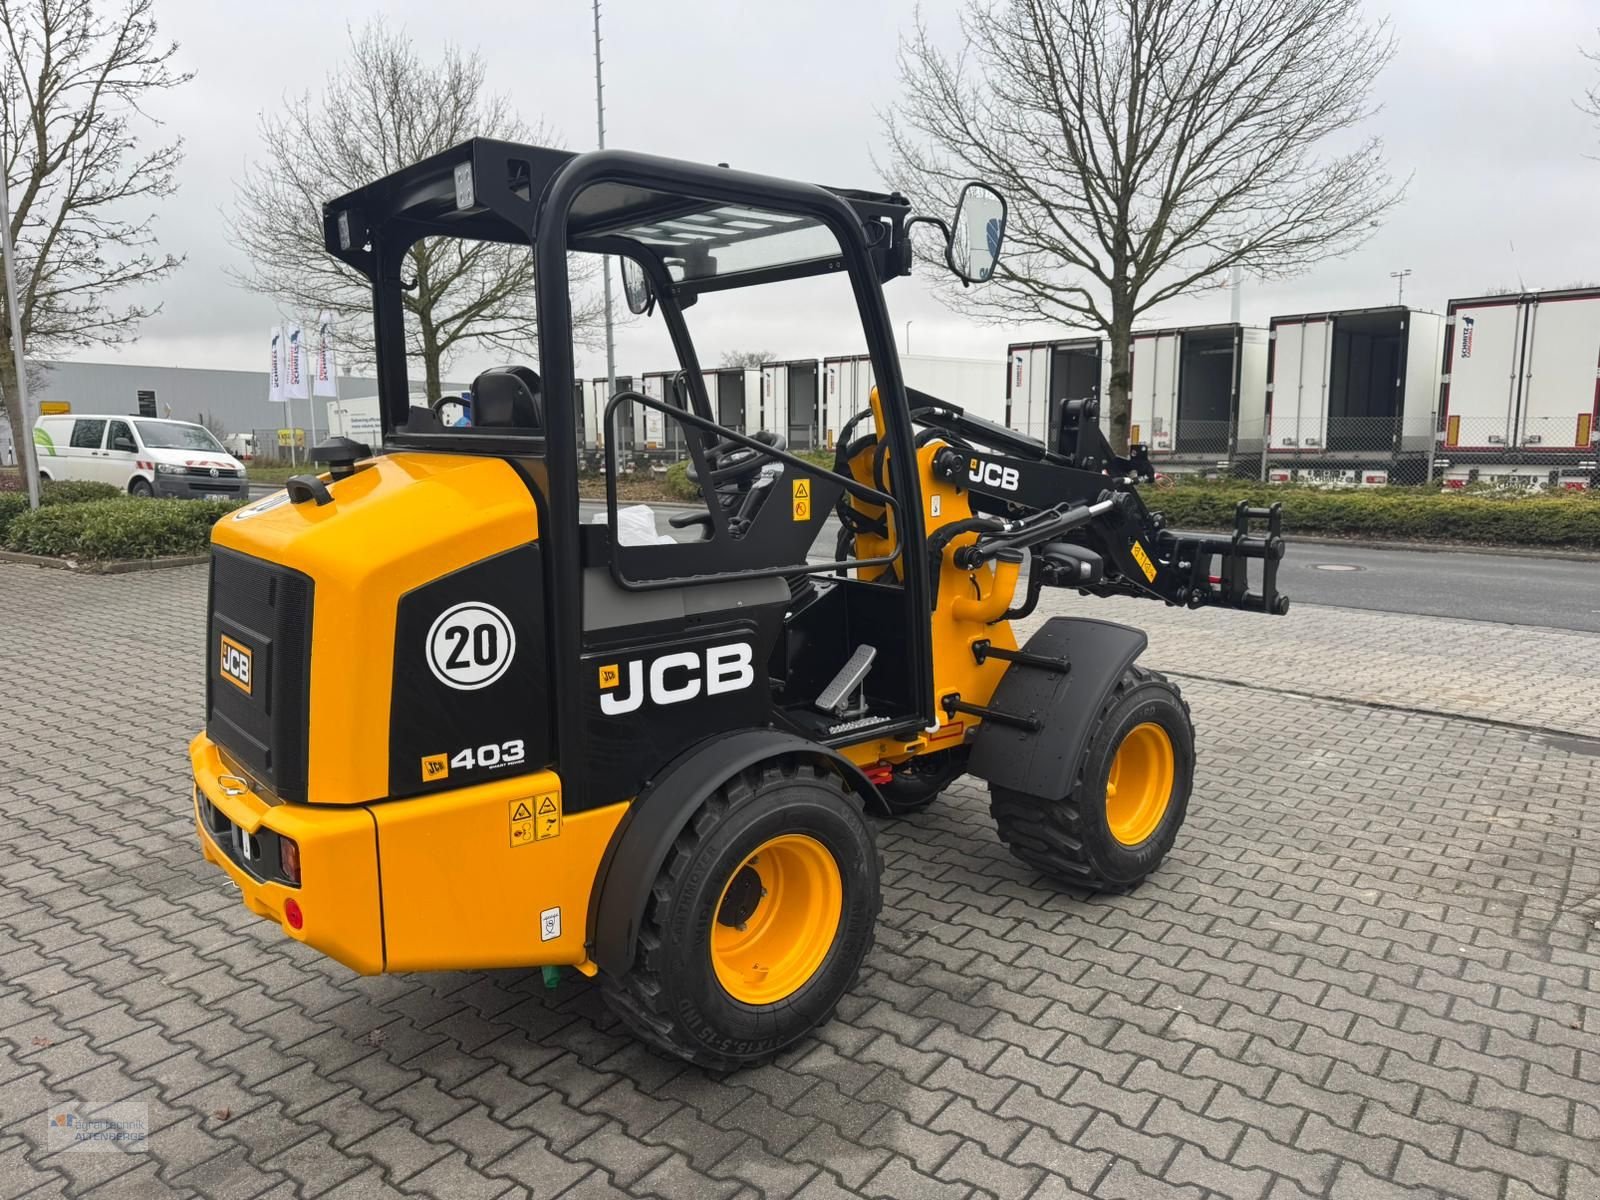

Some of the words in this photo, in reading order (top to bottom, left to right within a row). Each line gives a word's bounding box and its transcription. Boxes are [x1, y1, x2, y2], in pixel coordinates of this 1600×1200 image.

[1461, 327, 1469, 358] SCHMITZ
[968, 460, 1020, 491] JCB
[445, 623, 498, 670] 20
[222, 644, 249, 684] JCB
[600, 642, 754, 716] JCB
[427, 761, 444, 774] JCB
[450, 739, 525, 770] 403
